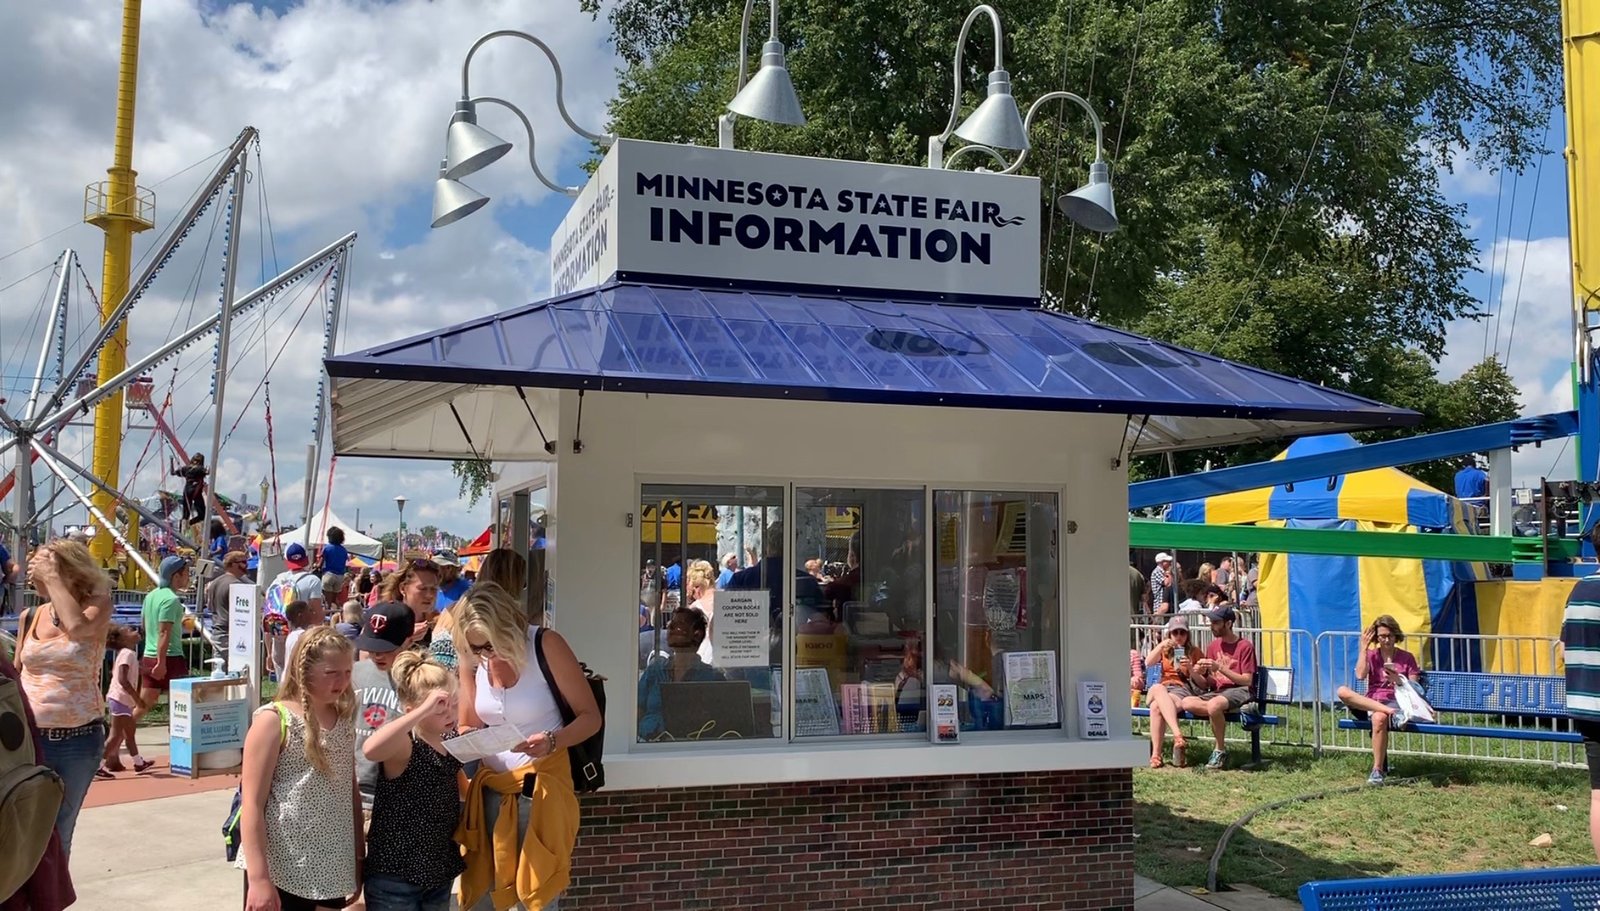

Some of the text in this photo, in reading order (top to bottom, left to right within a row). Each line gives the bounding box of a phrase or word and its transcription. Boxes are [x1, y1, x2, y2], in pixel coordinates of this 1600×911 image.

[636, 171, 1025, 229] MINNESOTA STATE FAIR
[552, 183, 615, 277] MINNESOTA STATE FAIR
[554, 218, 608, 298] INFORMATION
[650, 207, 991, 265] INFORMATION
[236, 596, 249, 607] Free
[174, 701, 187, 712] Free
[1475, 678, 1563, 709] PAUL
